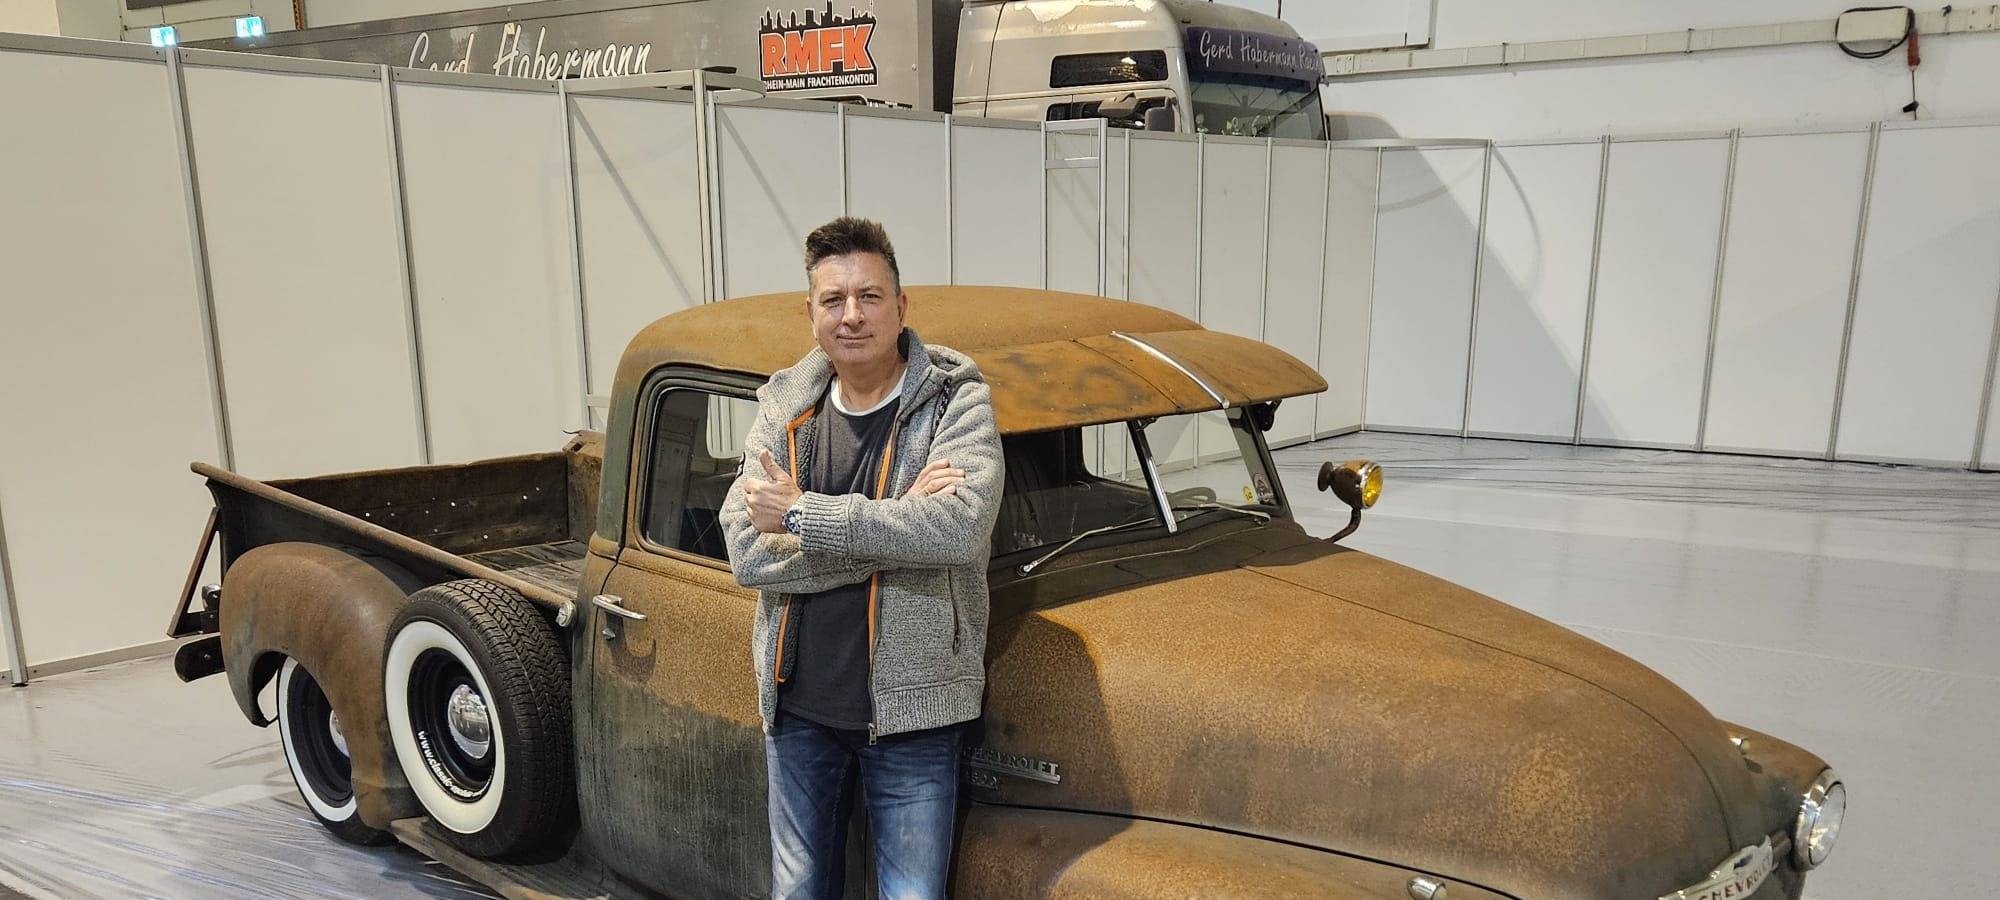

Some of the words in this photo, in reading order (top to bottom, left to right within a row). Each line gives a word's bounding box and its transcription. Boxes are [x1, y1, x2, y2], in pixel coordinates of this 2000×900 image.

[493, 24, 651, 79] Habermann
[761, 24, 874, 77] RMFK
[1200, 30, 1233, 67] Gerd
[807, 73, 874, 88] FRACHTENKONTOR
